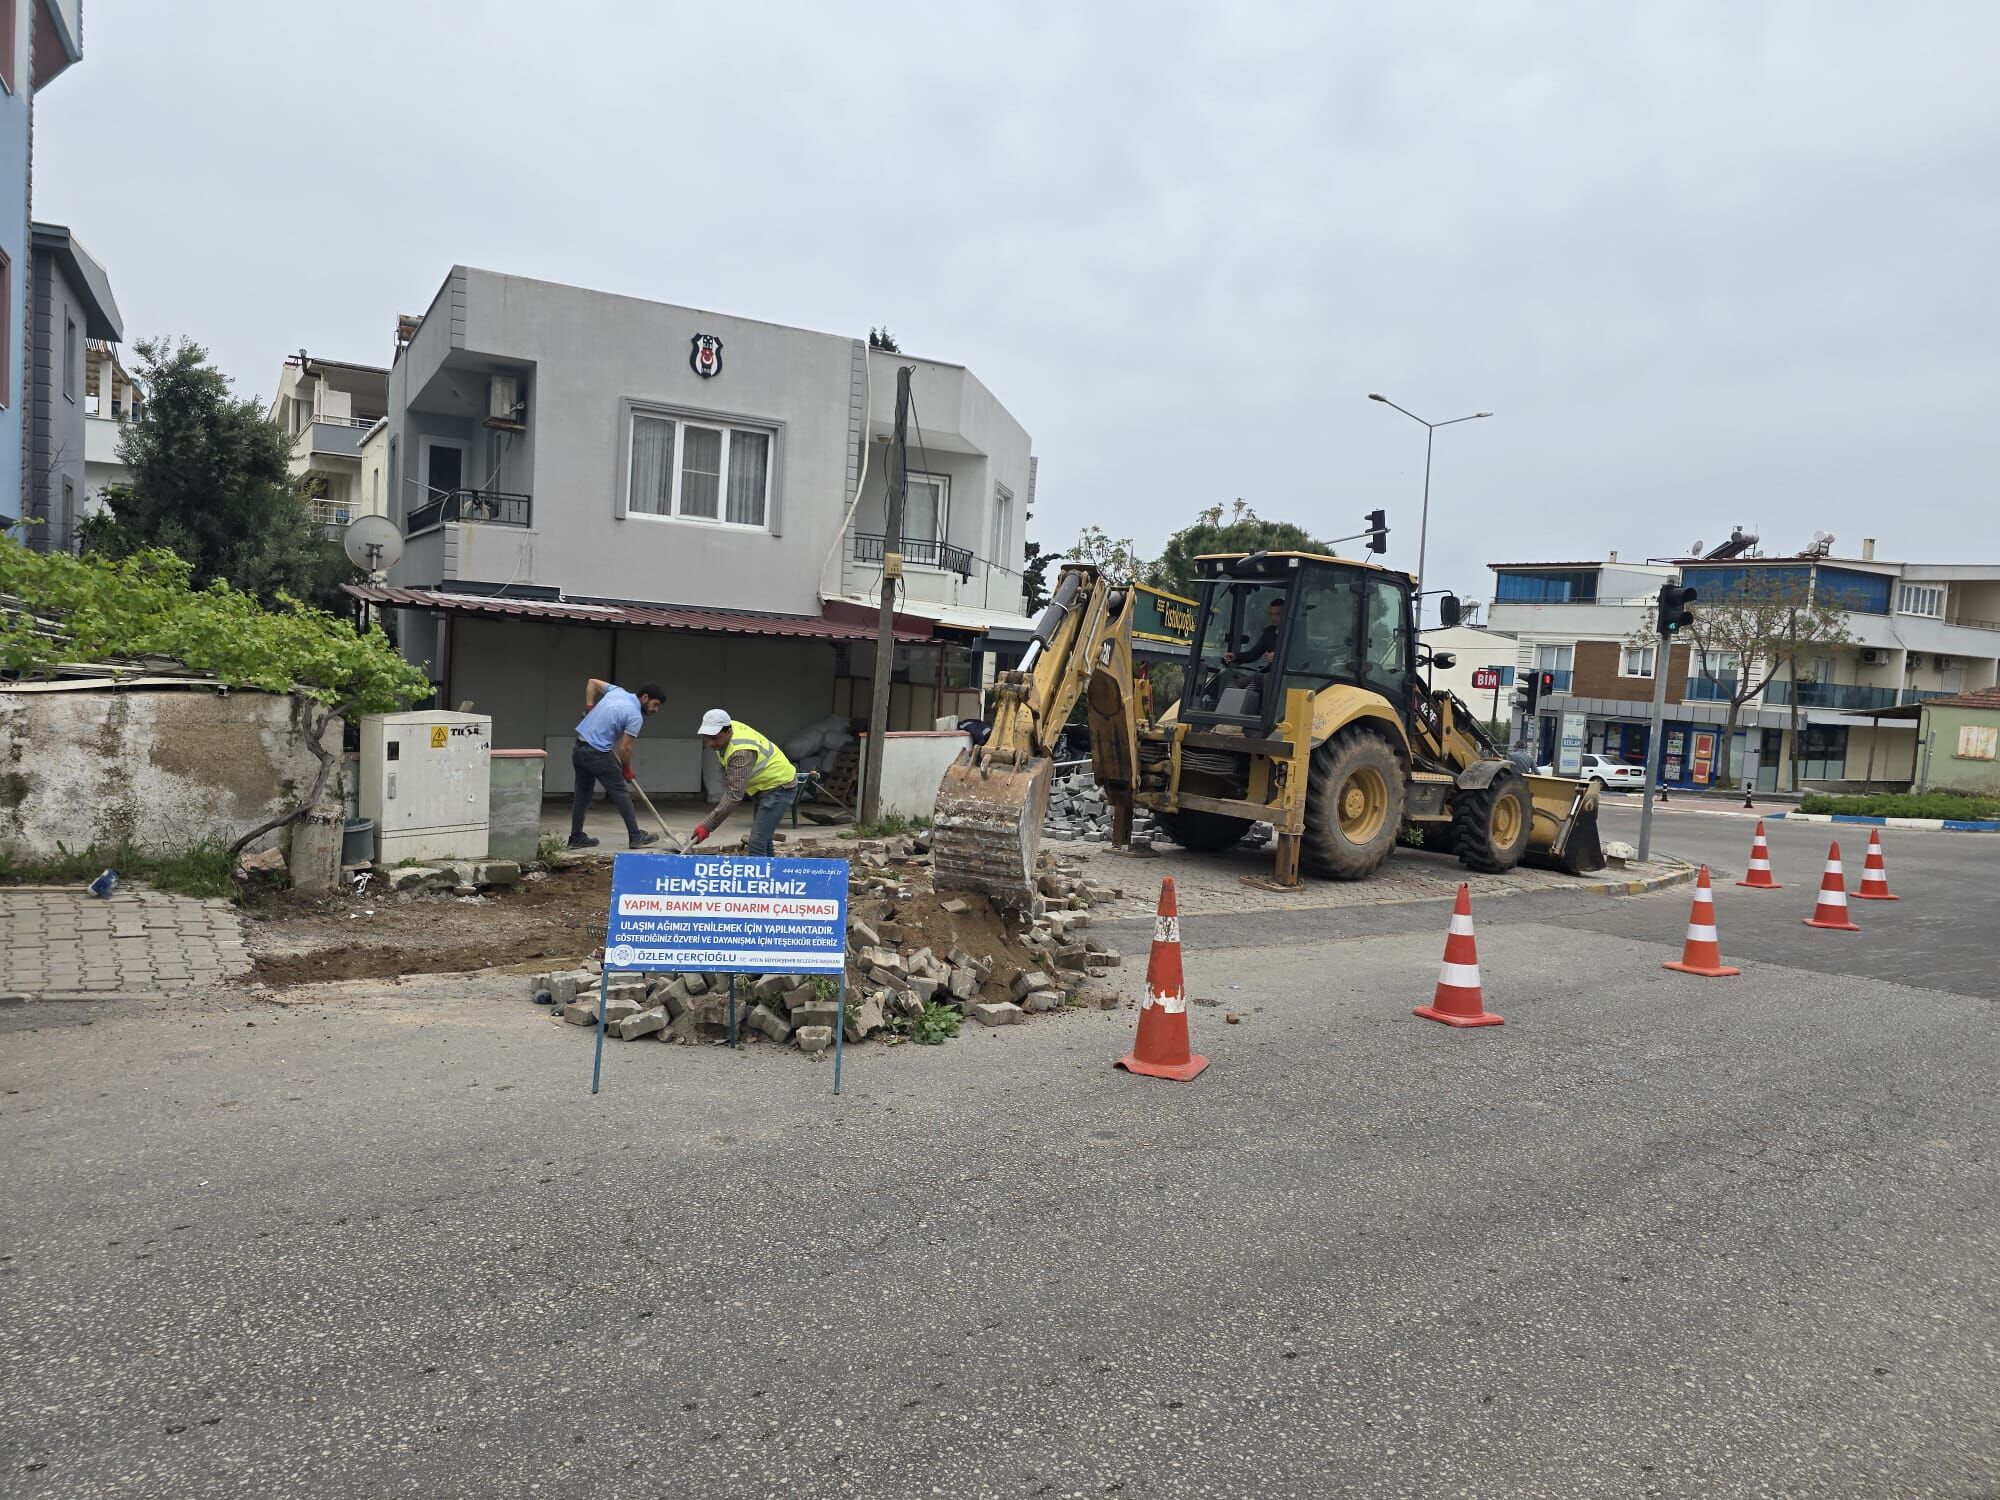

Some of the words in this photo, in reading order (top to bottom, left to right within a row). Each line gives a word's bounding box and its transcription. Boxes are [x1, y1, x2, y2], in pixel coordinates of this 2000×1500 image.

[1478, 671, 1497, 686] BİM
[694, 859, 771, 879] DEĞERLİ
[655, 877, 807, 896] HEMŞERİLERİMİZ
[624, 899, 662, 912] YAPIM,
[666, 901, 702, 912] BAKIM
[706, 902, 721, 912] VE
[724, 902, 770, 913] ONARIM
[773, 903, 834, 917] ÇALIŞMASI
[620, 920, 655, 933] ULAŞIM
[656, 919, 690, 932] AĞIMIZI
[692, 921, 743, 933] YENİLEMEK
[744, 922, 762, 935] İÇİN
[764, 924, 834, 935] YAPILMAKTADIR.
[615, 933, 672, 943] GÖSTERDİĞİNİZ
[673, 934, 701, 944] ÖZVERİ
[701, 936, 713, 944] VE
[713, 936, 757, 947] DAYANIŞMA
[757, 936, 773, 947] İÇİN
[774, 937, 811, 947] TEŞEKKÜR
[812, 937, 838, 947] EDERİZ
[638, 950, 674, 961] ÖZLEM
[677, 951, 737, 963] ÇERÇİOĞLU
